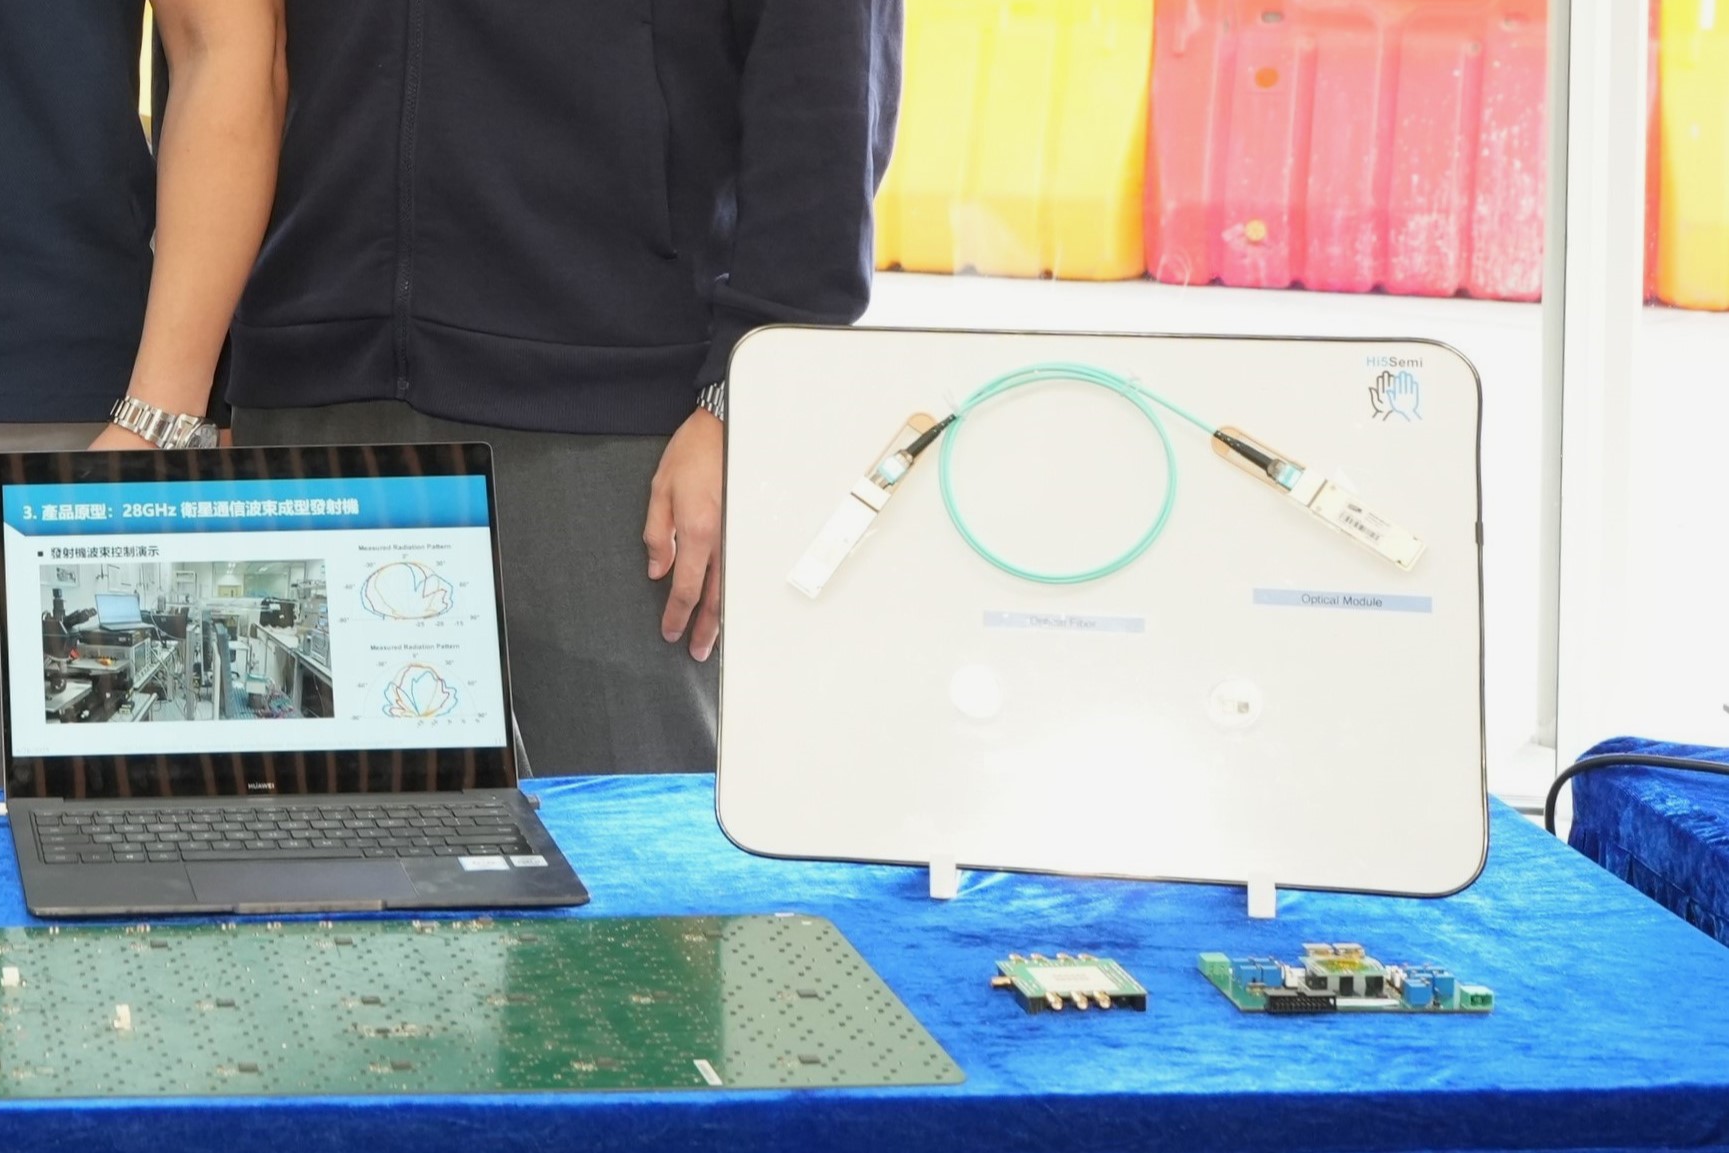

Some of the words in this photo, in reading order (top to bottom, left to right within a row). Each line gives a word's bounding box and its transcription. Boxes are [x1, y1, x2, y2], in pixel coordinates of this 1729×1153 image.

[1365, 355, 1424, 369] Hi5Semi
[22, 506, 38, 520] 3.
[122, 503, 177, 519] 28GHz
[358, 544, 391, 552] Measured
[393, 543, 425, 551] Radiation
[1301, 593, 1339, 608] Optical
[1342, 594, 1383, 608] Module
[1069, 616, 1097, 628] Fiber
[248, 782, 275, 790] HUAWEI
